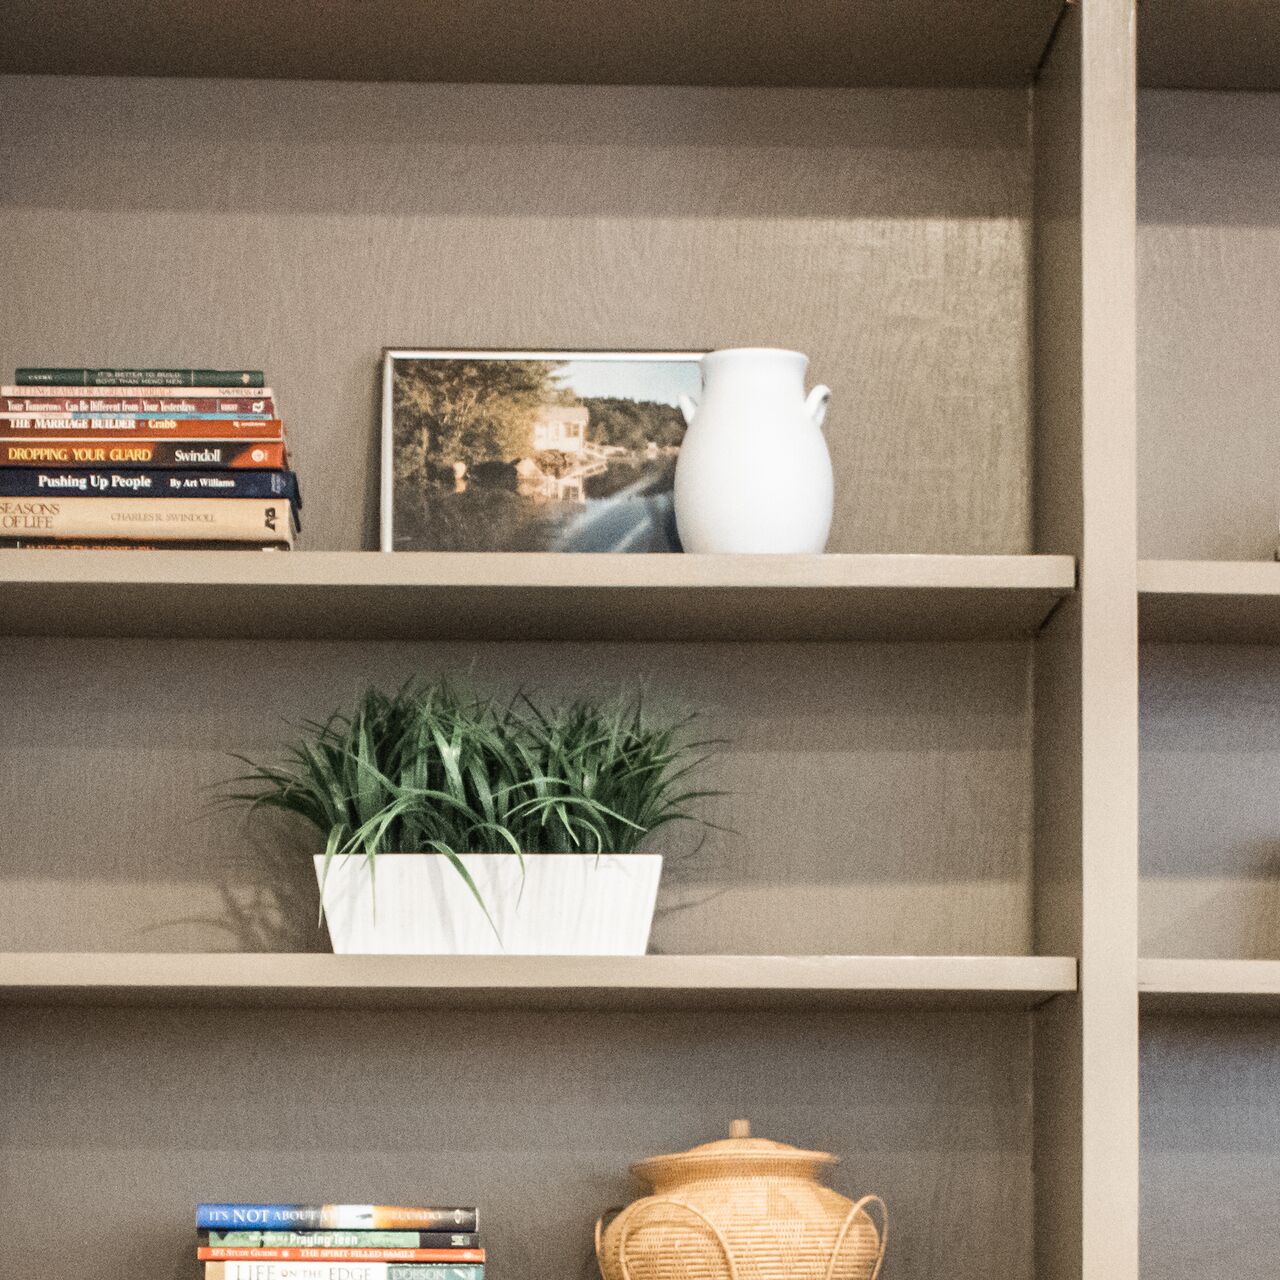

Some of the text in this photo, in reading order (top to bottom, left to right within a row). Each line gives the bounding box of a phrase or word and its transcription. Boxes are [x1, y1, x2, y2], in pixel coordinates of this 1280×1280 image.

[7, 400, 24, 411] Your
[65, 400, 78, 411] Can
[80, 400, 89, 411] Be
[90, 400, 120, 411] Different
[142, 400, 159, 412] Your
[9, 419, 177, 429] THE MARRIAGE BUILDER Crabb
[8, 447, 221, 462] DROPPING YOUR GUARD Swindoll
[38, 474, 235, 490] Pushing Up People By Art Williams
[2, 515, 53, 528] OF LIFE
[111, 512, 216, 522] CHARLES SWINDOLL
[209, 1209, 228, 1221] IT'S
[232, 1208, 270, 1223] NOT
[272, 1209, 316, 1221] ABOUT
[289, 1233, 330, 1248] Praying
[333, 1233, 358, 1245] Teen
[300, 1250, 319, 1258] THE
[383, 1250, 416, 1258] FAMILY
[281, 1269, 297, 1278] ON
[303, 1269, 323, 1278] THE
[392, 1268, 446, 1280] DOBSON
